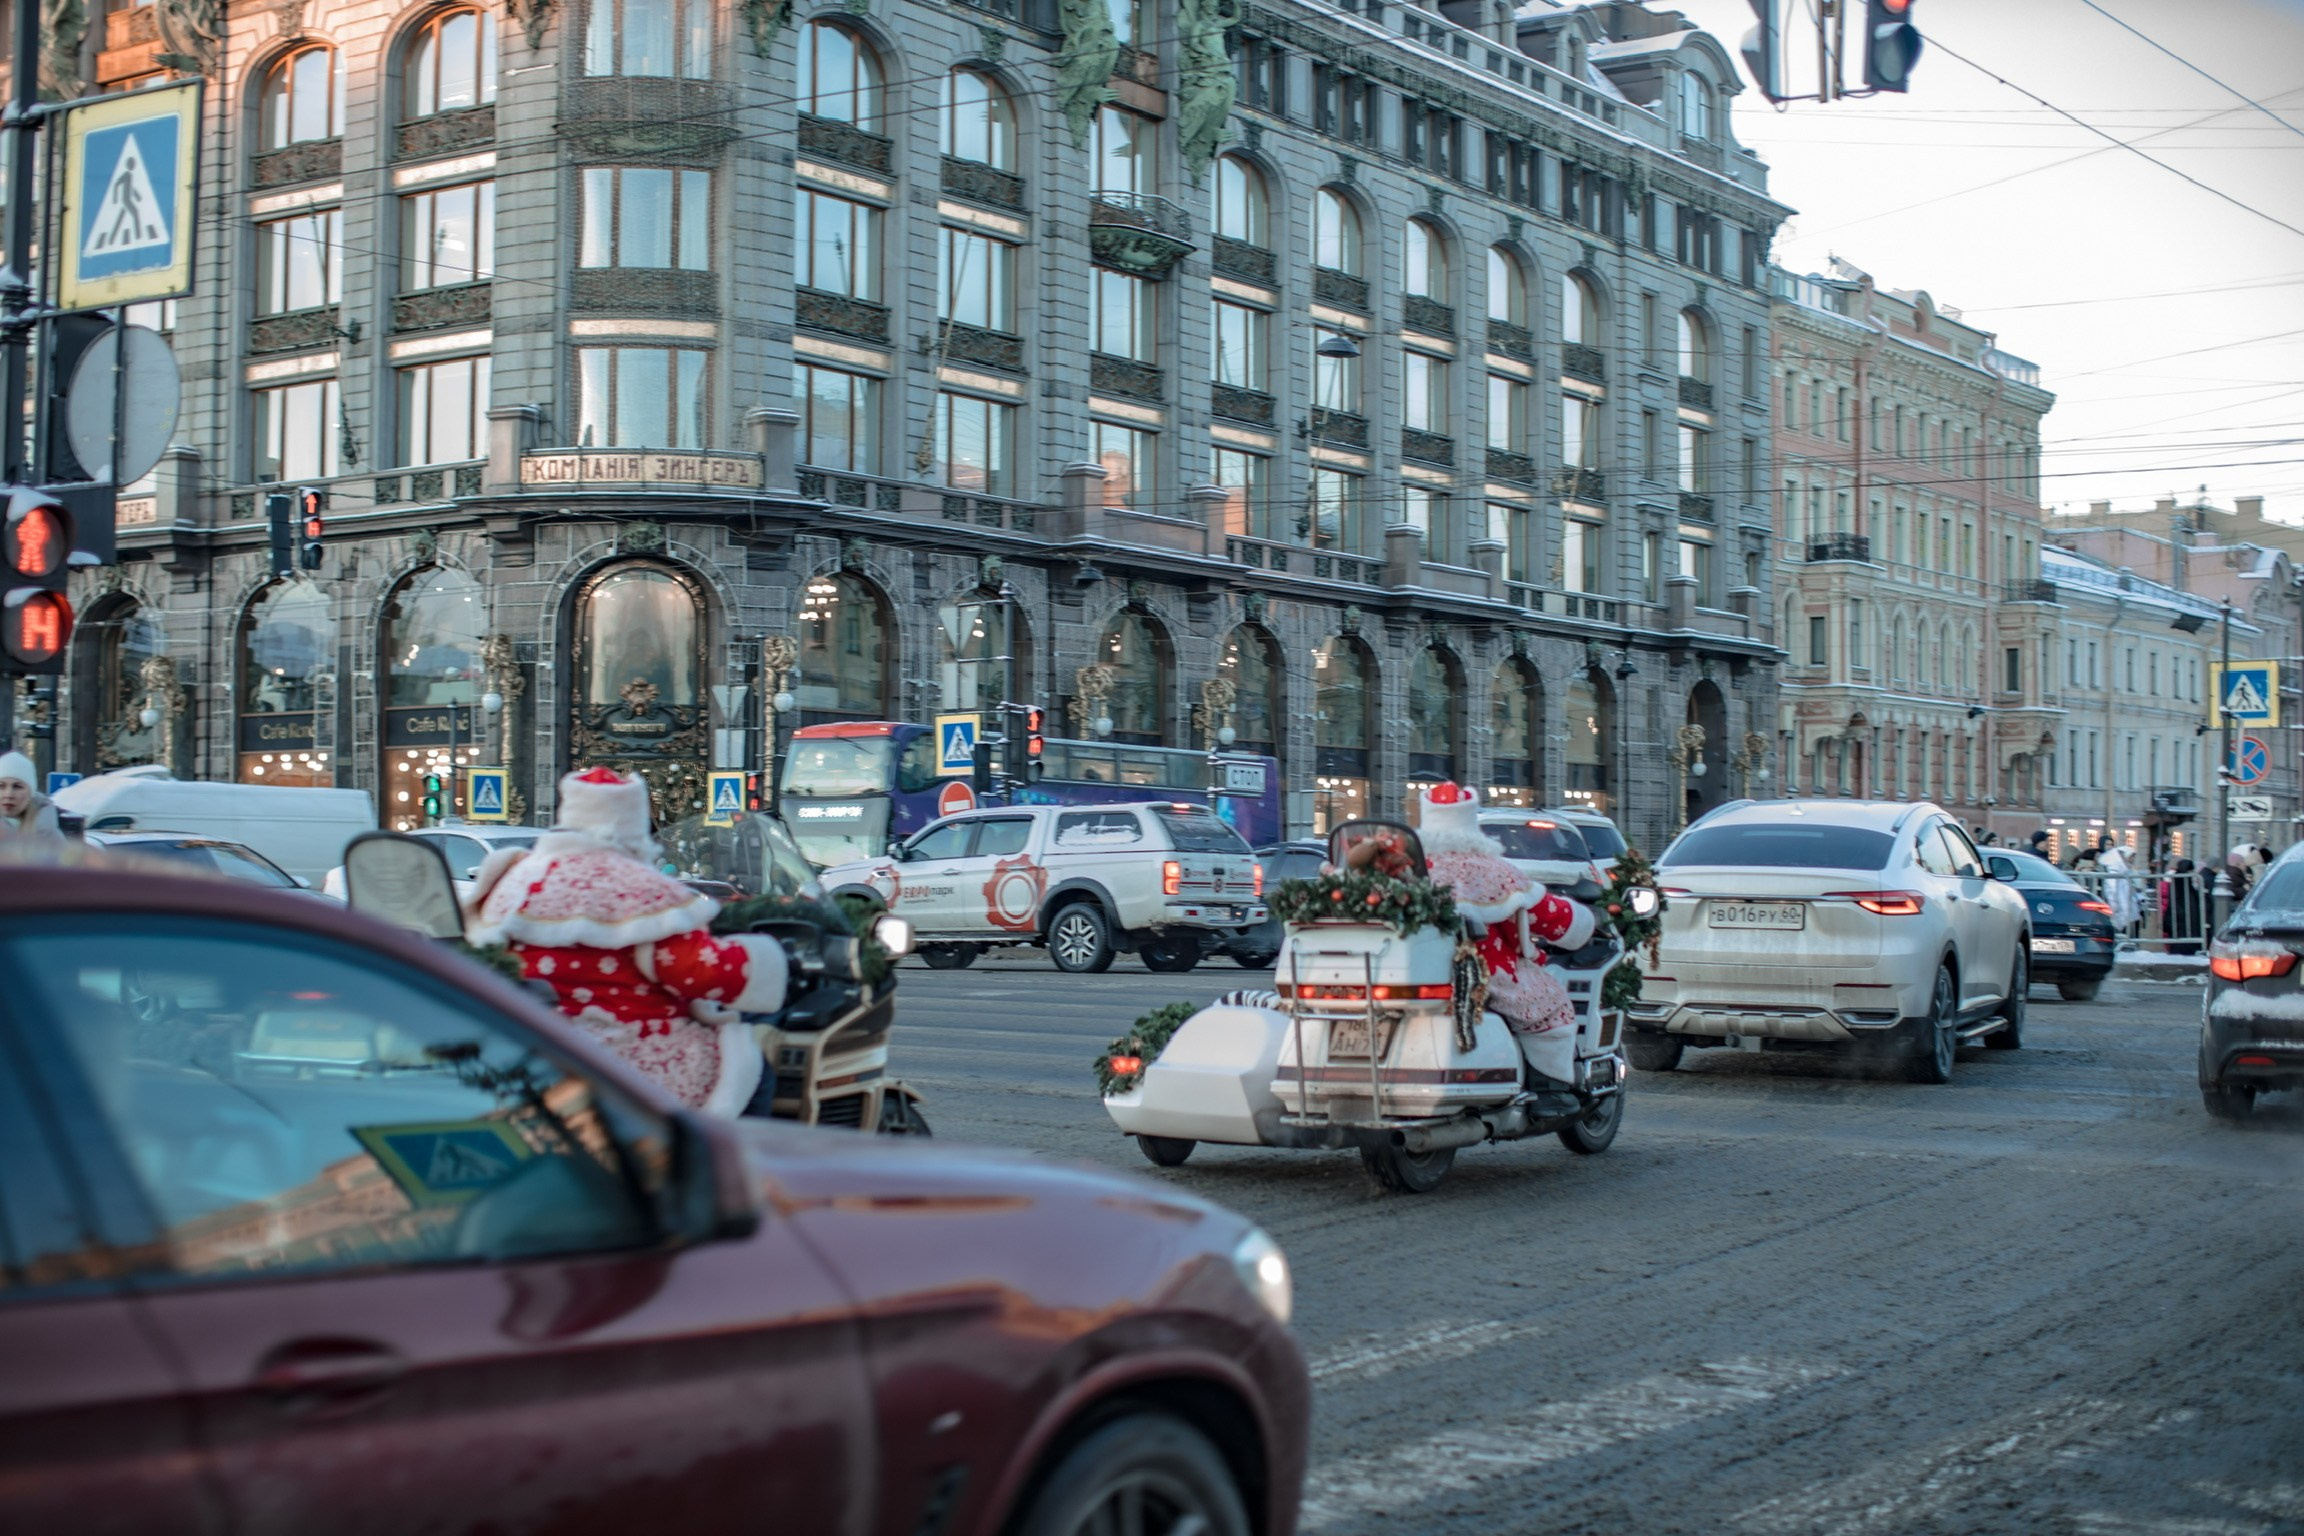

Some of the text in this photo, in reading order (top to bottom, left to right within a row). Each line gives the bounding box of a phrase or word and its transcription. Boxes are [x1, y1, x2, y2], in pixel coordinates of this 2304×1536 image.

[533, 457, 749, 484] КОМПАНІЯ ЗИНГЕРЪ
[1231, 769, 1260, 786] СТОП
